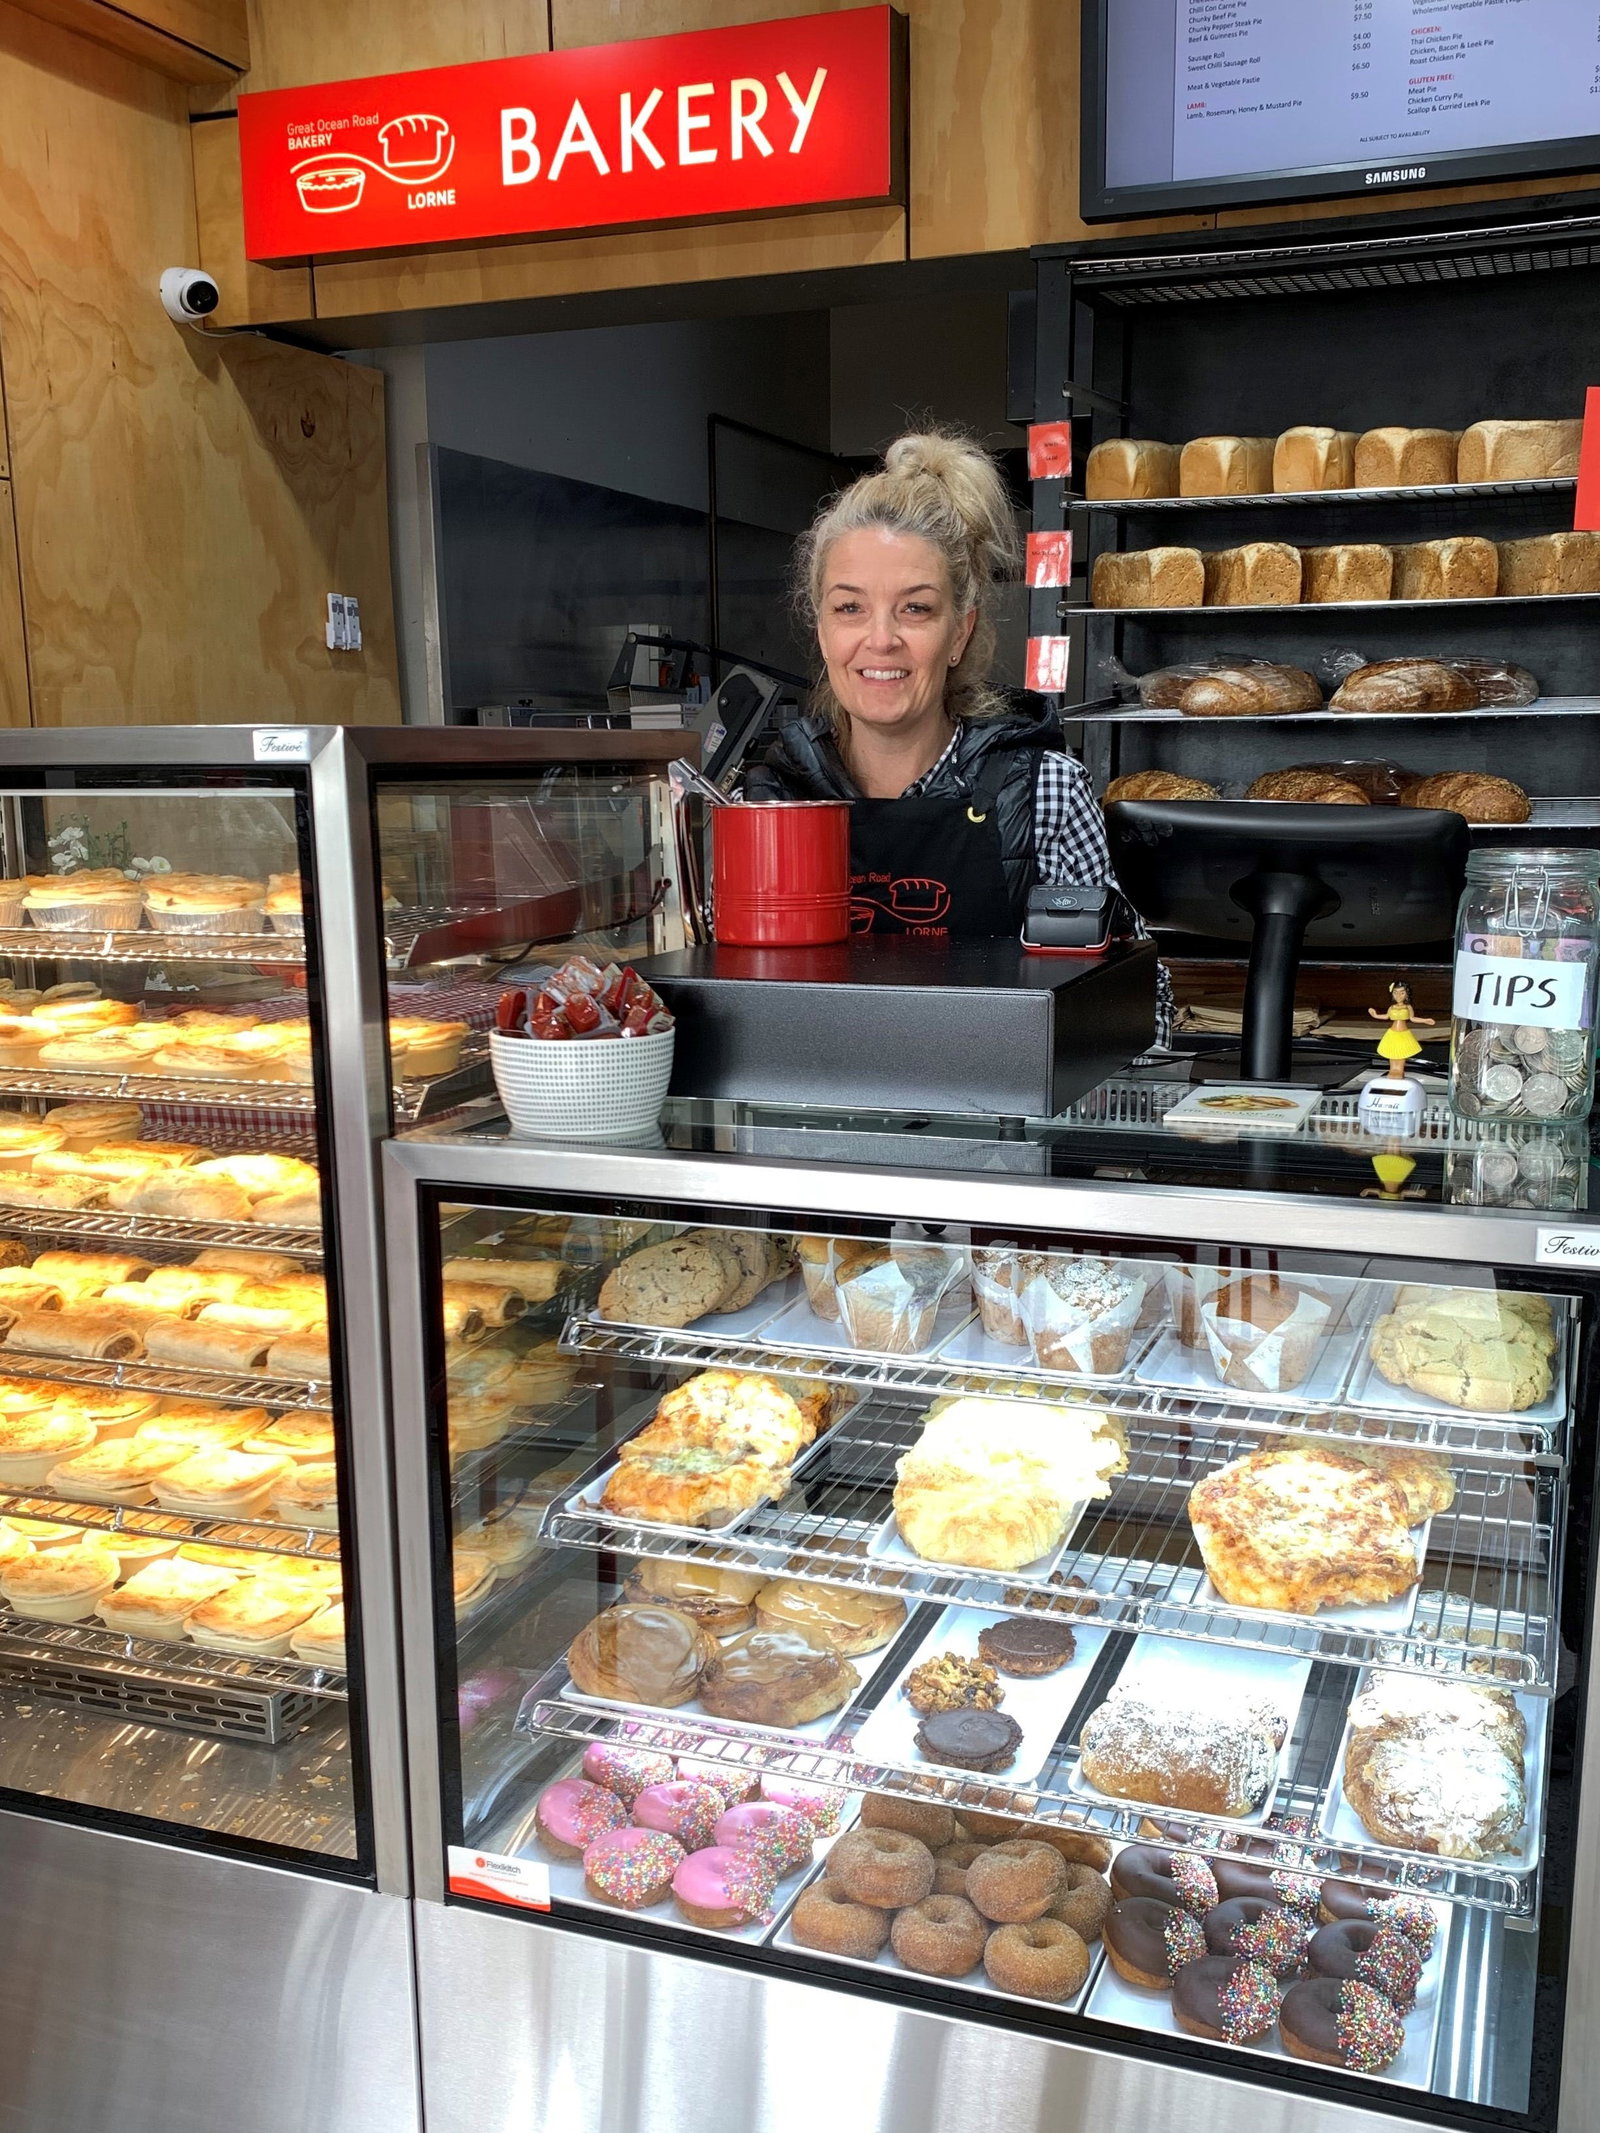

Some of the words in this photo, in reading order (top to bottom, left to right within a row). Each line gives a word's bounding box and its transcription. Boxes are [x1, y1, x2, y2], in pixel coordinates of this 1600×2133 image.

[1354, 2, 1372, 12] $6.50
[1412, 4, 1449, 15] Wholemeal
[1450, 2, 1482, 10] Vegetable
[1188, 16, 1211, 24] Chunky
[1212, 12, 1226, 20] Beef
[1354, 12, 1372, 22] $7.50
[1188, 25, 1211, 34] Chunky
[1212, 22, 1234, 31] Pepper
[1188, 35, 1202, 43] Beef
[1353, 32, 1372, 41] $4.00
[1410, 38, 1424, 46] Thai
[1426, 34, 1451, 43] Chicken
[1352, 42, 1371, 51] $5.00
[1410, 47, 1437, 56] Chicken,
[1438, 44, 1458, 52] Bacon
[1467, 40, 1482, 48] Leek
[1188, 54, 1212, 62] Sausage
[1213, 51, 1225, 59] Roll
[1410, 57, 1428, 65] Roast
[1428, 53, 1454, 62] Chicken
[1188, 63, 1206, 72] Sweet
[1207, 60, 1222, 70] Chilli
[1224, 58, 1248, 68] Sausage
[1352, 62, 1370, 71] $6.50
[1187, 83, 1203, 92] Meat
[1211, 78, 1240, 88] Vegetable
[1242, 76, 1260, 84] Pastie
[1408, 76, 1435, 85] GLUTEN
[1350, 91, 1369, 100] $9.50
[1408, 87, 1425, 95] Meat
[1408, 96, 1432, 105] Chicken
[1434, 94, 1452, 102] Curry
[1186, 111, 1204, 120] Lamb,
[1238, 105, 1258, 114] Honey
[1266, 100, 1292, 110] Mustard
[1407, 106, 1430, 115] Scallop
[1438, 102, 1462, 112] Curried
[1464, 101, 1478, 109] Leek
[287, 122, 315, 136] Great
[317, 118, 350, 132] Ocean
[352, 112, 380, 127] Road
[500, 66, 828, 186] BAKERY
[288, 133, 332, 150] BAKERY
[1365, 167, 1426, 185] SAMSUNG
[408, 189, 456, 209] LORNE
[868, 872, 891, 882] Road
[1472, 972, 1559, 1008] TIPS
[1544, 1236, 1600, 1256] Festiv
